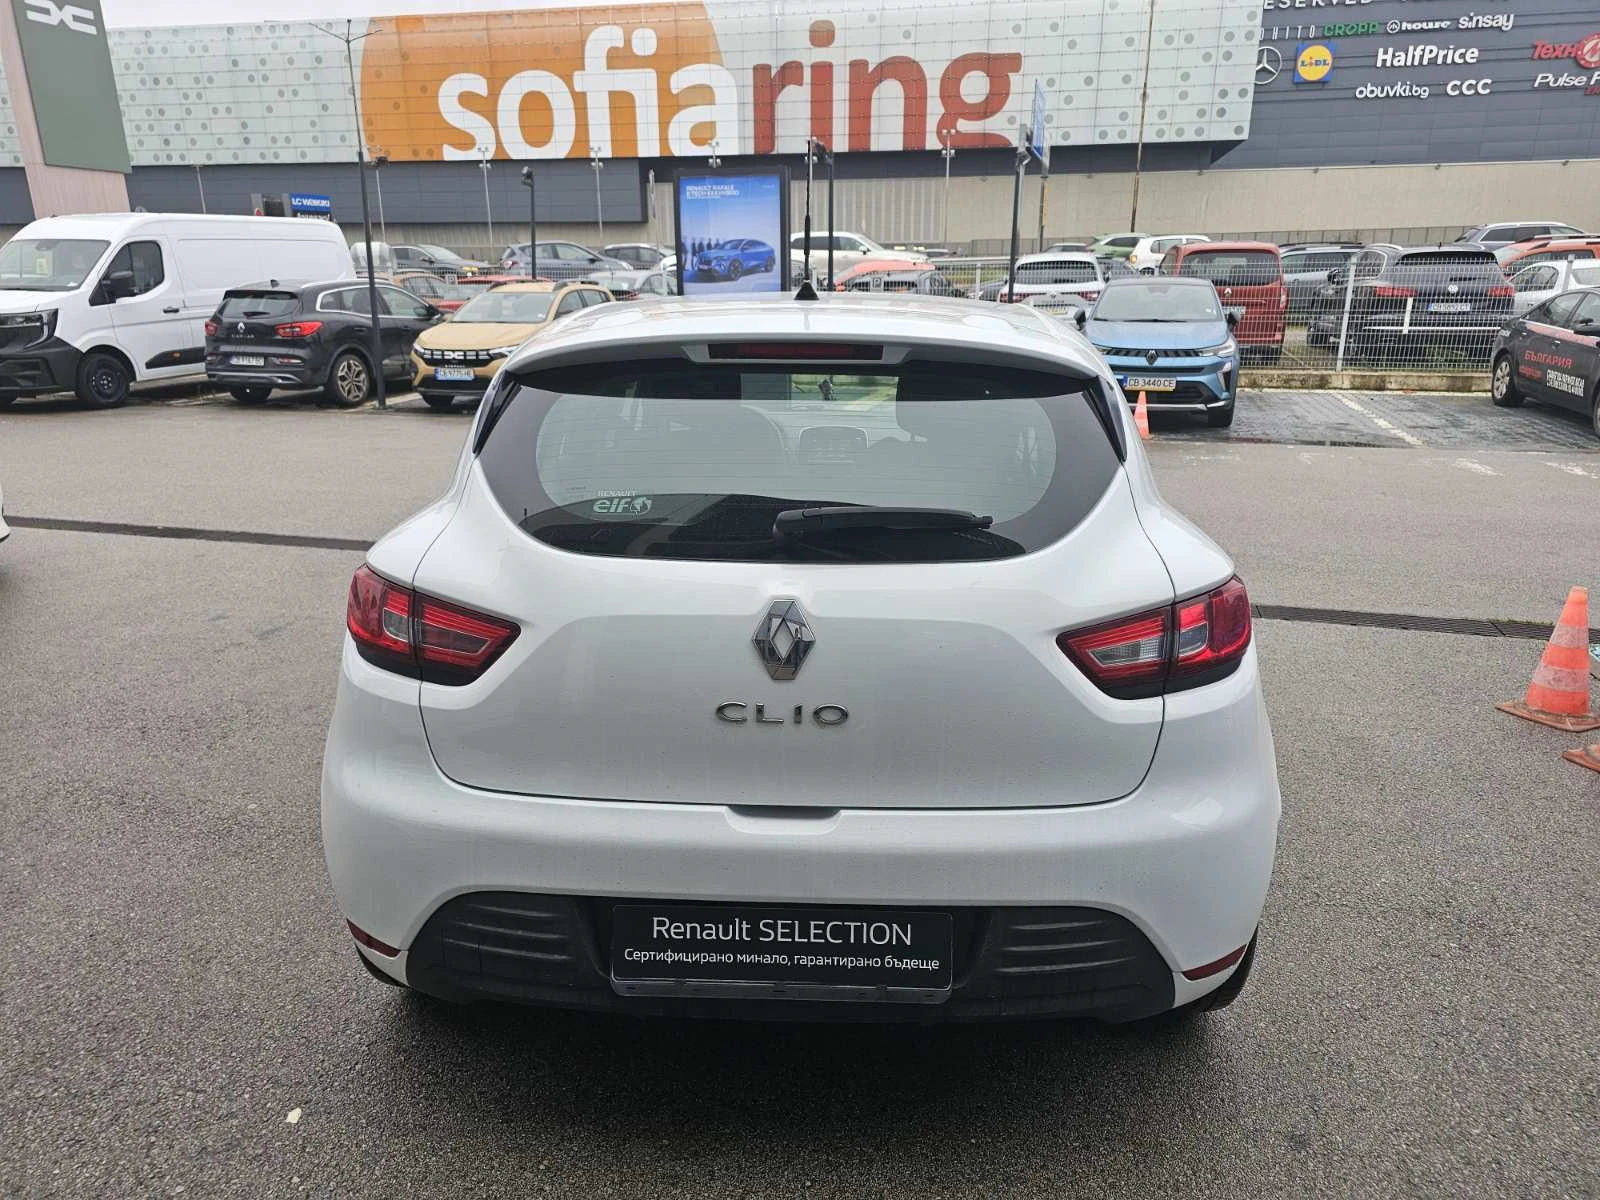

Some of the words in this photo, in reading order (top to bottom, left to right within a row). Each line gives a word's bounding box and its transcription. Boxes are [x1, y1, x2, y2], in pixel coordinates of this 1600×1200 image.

[1324, 21, 1379, 36] CROPP
[1401, 20, 1451, 31] house
[1458, 12, 1514, 31] sinsay
[1376, 44, 1479, 67] HalfPrice
[1446, 78, 1492, 96] CCC
[1533, 72, 1587, 87] Pulse
[438, 19, 1022, 160] sofiaring
[1355, 81, 1430, 98] obuvki.bg
[1524, 350, 1573, 368] БЪЛГАРИЯ
[1128, 378, 1139, 387] CB
[1140, 378, 1162, 387] 3440
[1163, 379, 1174, 387] CE
[593, 498, 631, 513] elf
[716, 701, 849, 725] CLIO
[652, 917, 751, 941] Renault
[759, 919, 912, 946] SELECTION
[624, 948, 734, 964] Сертифицирано
[736, 951, 790, 965] минало,
[794, 955, 881, 969] гарантирано
[884, 955, 940, 971] бъдеще
